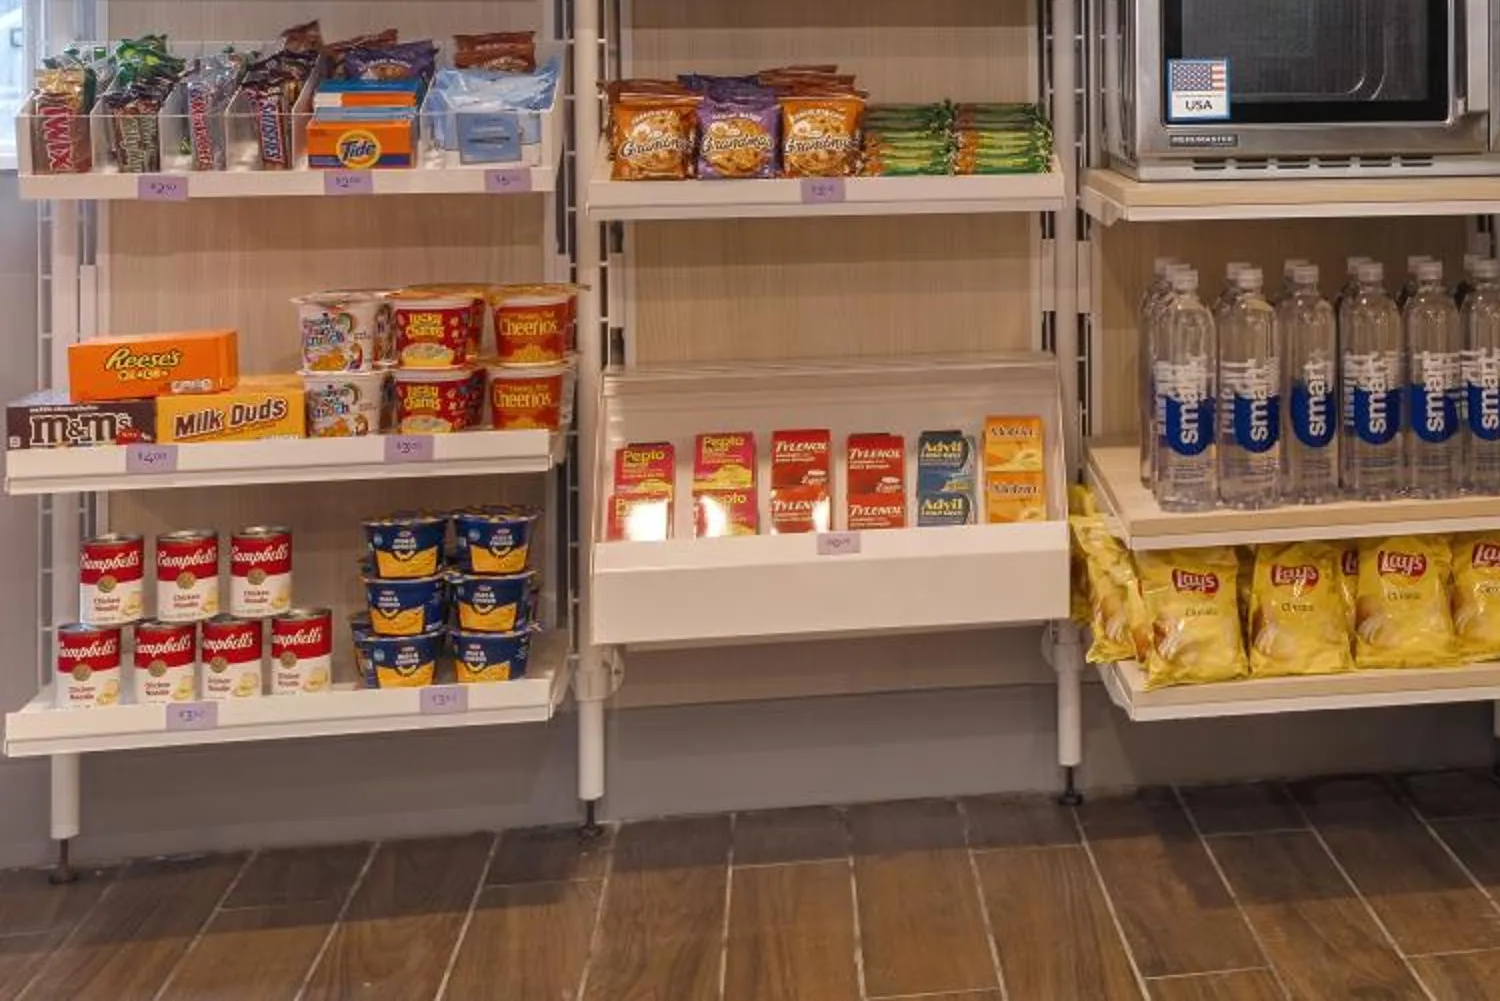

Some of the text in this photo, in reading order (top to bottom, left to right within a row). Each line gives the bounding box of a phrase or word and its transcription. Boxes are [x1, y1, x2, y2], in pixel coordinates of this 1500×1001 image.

[1185, 100, 1213, 111] USA
[341, 139, 376, 160] Tide
[500, 318, 560, 336] Cheerios
[105, 346, 182, 370] Reese's
[1305, 359, 1327, 437] smart
[174, 408, 224, 437] Milk
[229, 398, 287, 426] Duds
[849, 448, 901, 459] TYLENOL
[922, 440, 962, 453] Advil
[850, 504, 902, 516] TYLENOL
[922, 498, 963, 510] Advil
[157, 546, 218, 570] Campbell's
[1382, 552, 1424, 573] Lay's
[1176, 571, 1218, 592] Lay's
